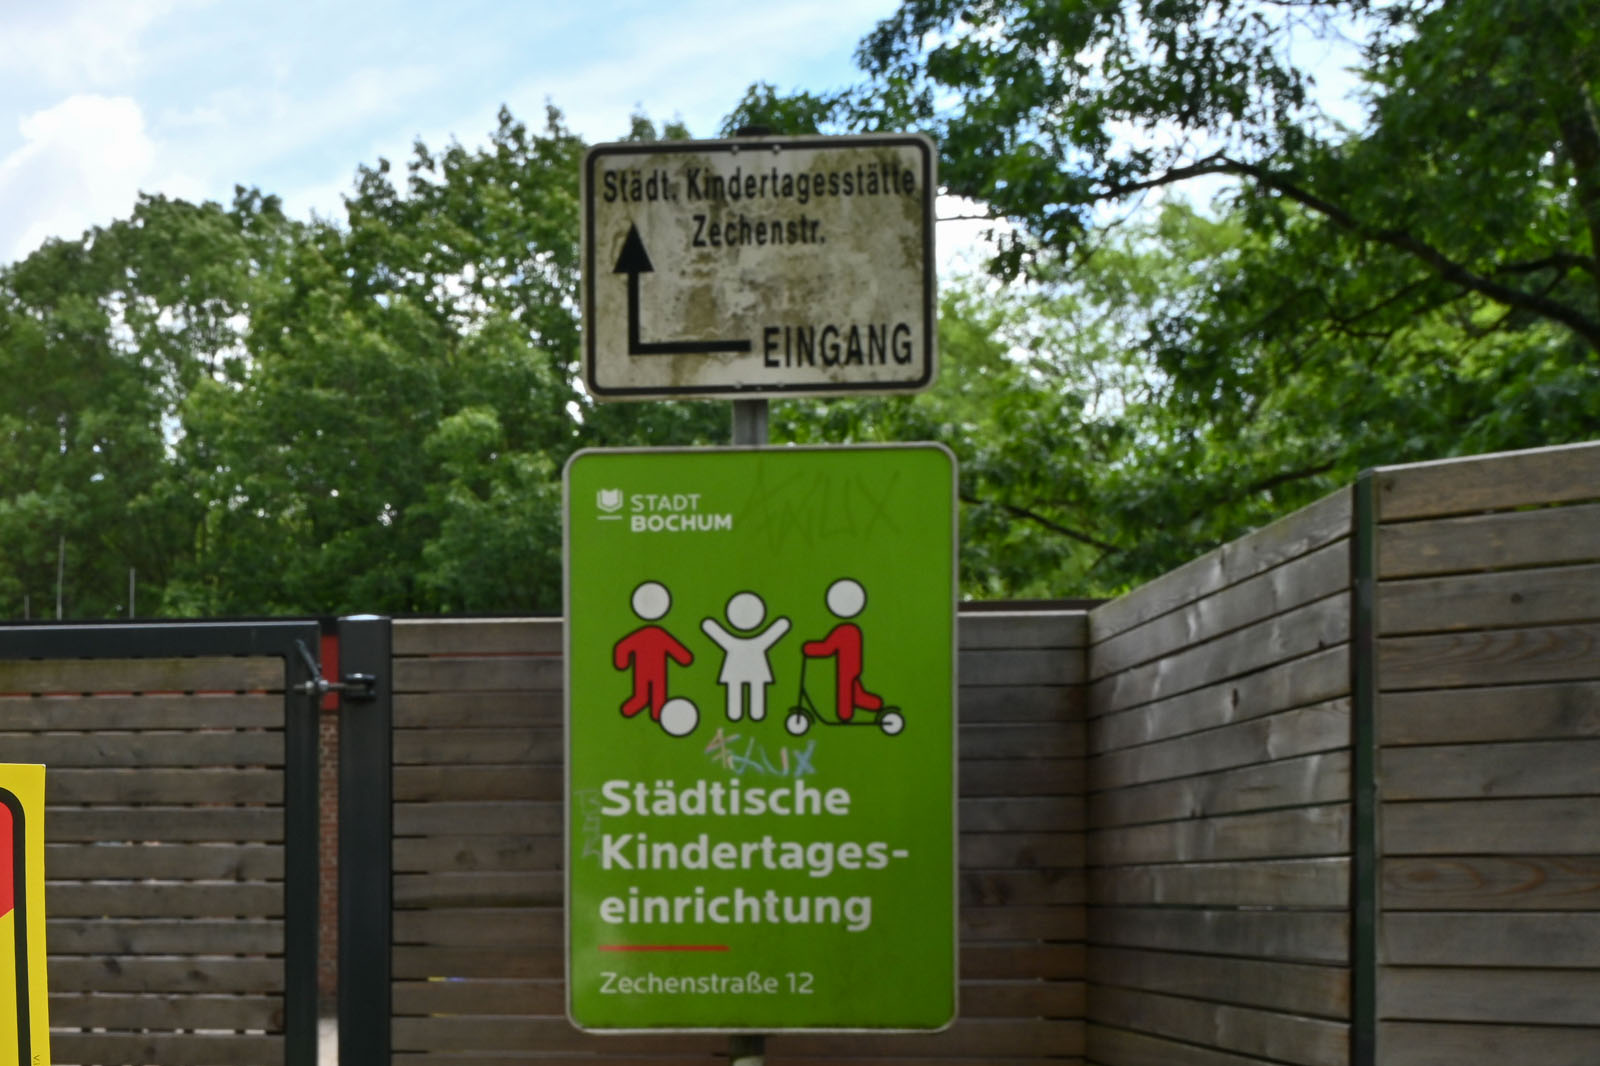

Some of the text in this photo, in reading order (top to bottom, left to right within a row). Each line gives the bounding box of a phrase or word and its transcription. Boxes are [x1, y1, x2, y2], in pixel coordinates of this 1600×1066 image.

[603, 164, 916, 205] Städt. Kindertagesstätte
[692, 214, 826, 247] Zechenstr.
[763, 322, 913, 368] EINGANG
[630, 493, 701, 513] STADT
[630, 514, 732, 532] BOCHUM
[600, 779, 851, 817] Städtische
[601, 833, 910, 878] Kindertages-
[599, 887, 872, 931] einrichtung
[600, 971, 814, 995] Zechenstraße 12
